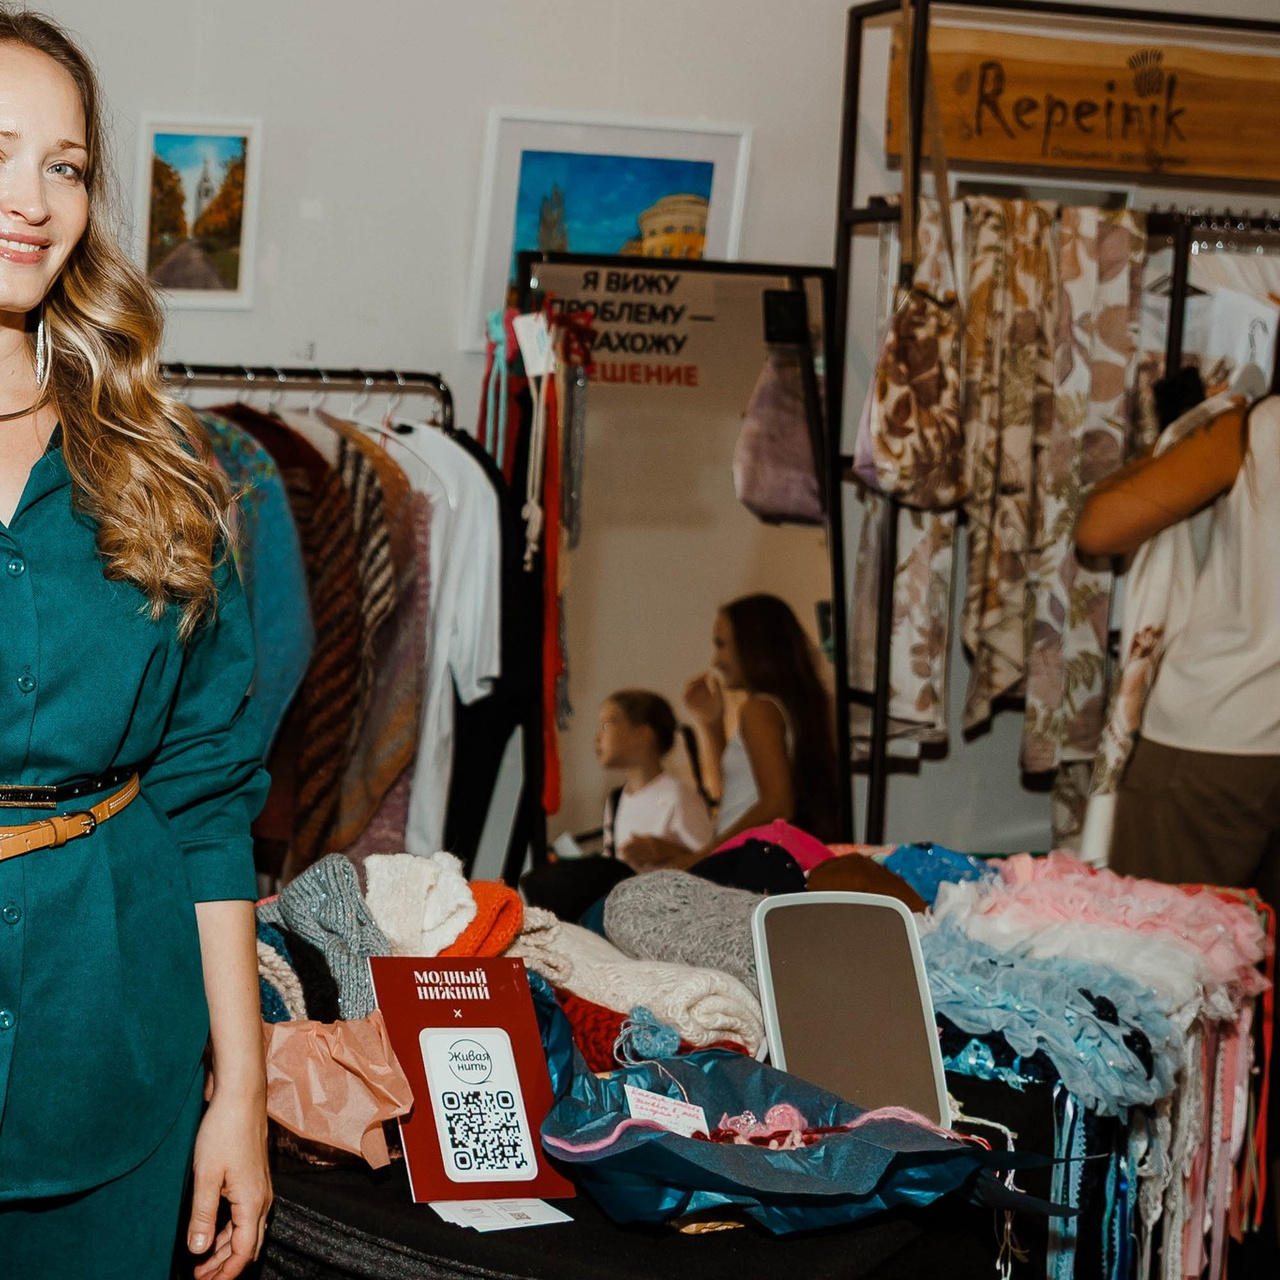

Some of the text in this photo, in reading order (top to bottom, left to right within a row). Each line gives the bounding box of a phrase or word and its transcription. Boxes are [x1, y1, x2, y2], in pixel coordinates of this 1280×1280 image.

[582, 271, 679, 295] Я ВИЖУ
[590, 331, 687, 355] АХОЖУ
[587, 362, 698, 387] ЕШЕНИЕ
[413, 968, 487, 986] МОДНЫЙ
[417, 984, 490, 1000] НИЖНИЙ
[448, 1050, 490, 1061] Живая
[457, 1063, 487, 1071] нить
